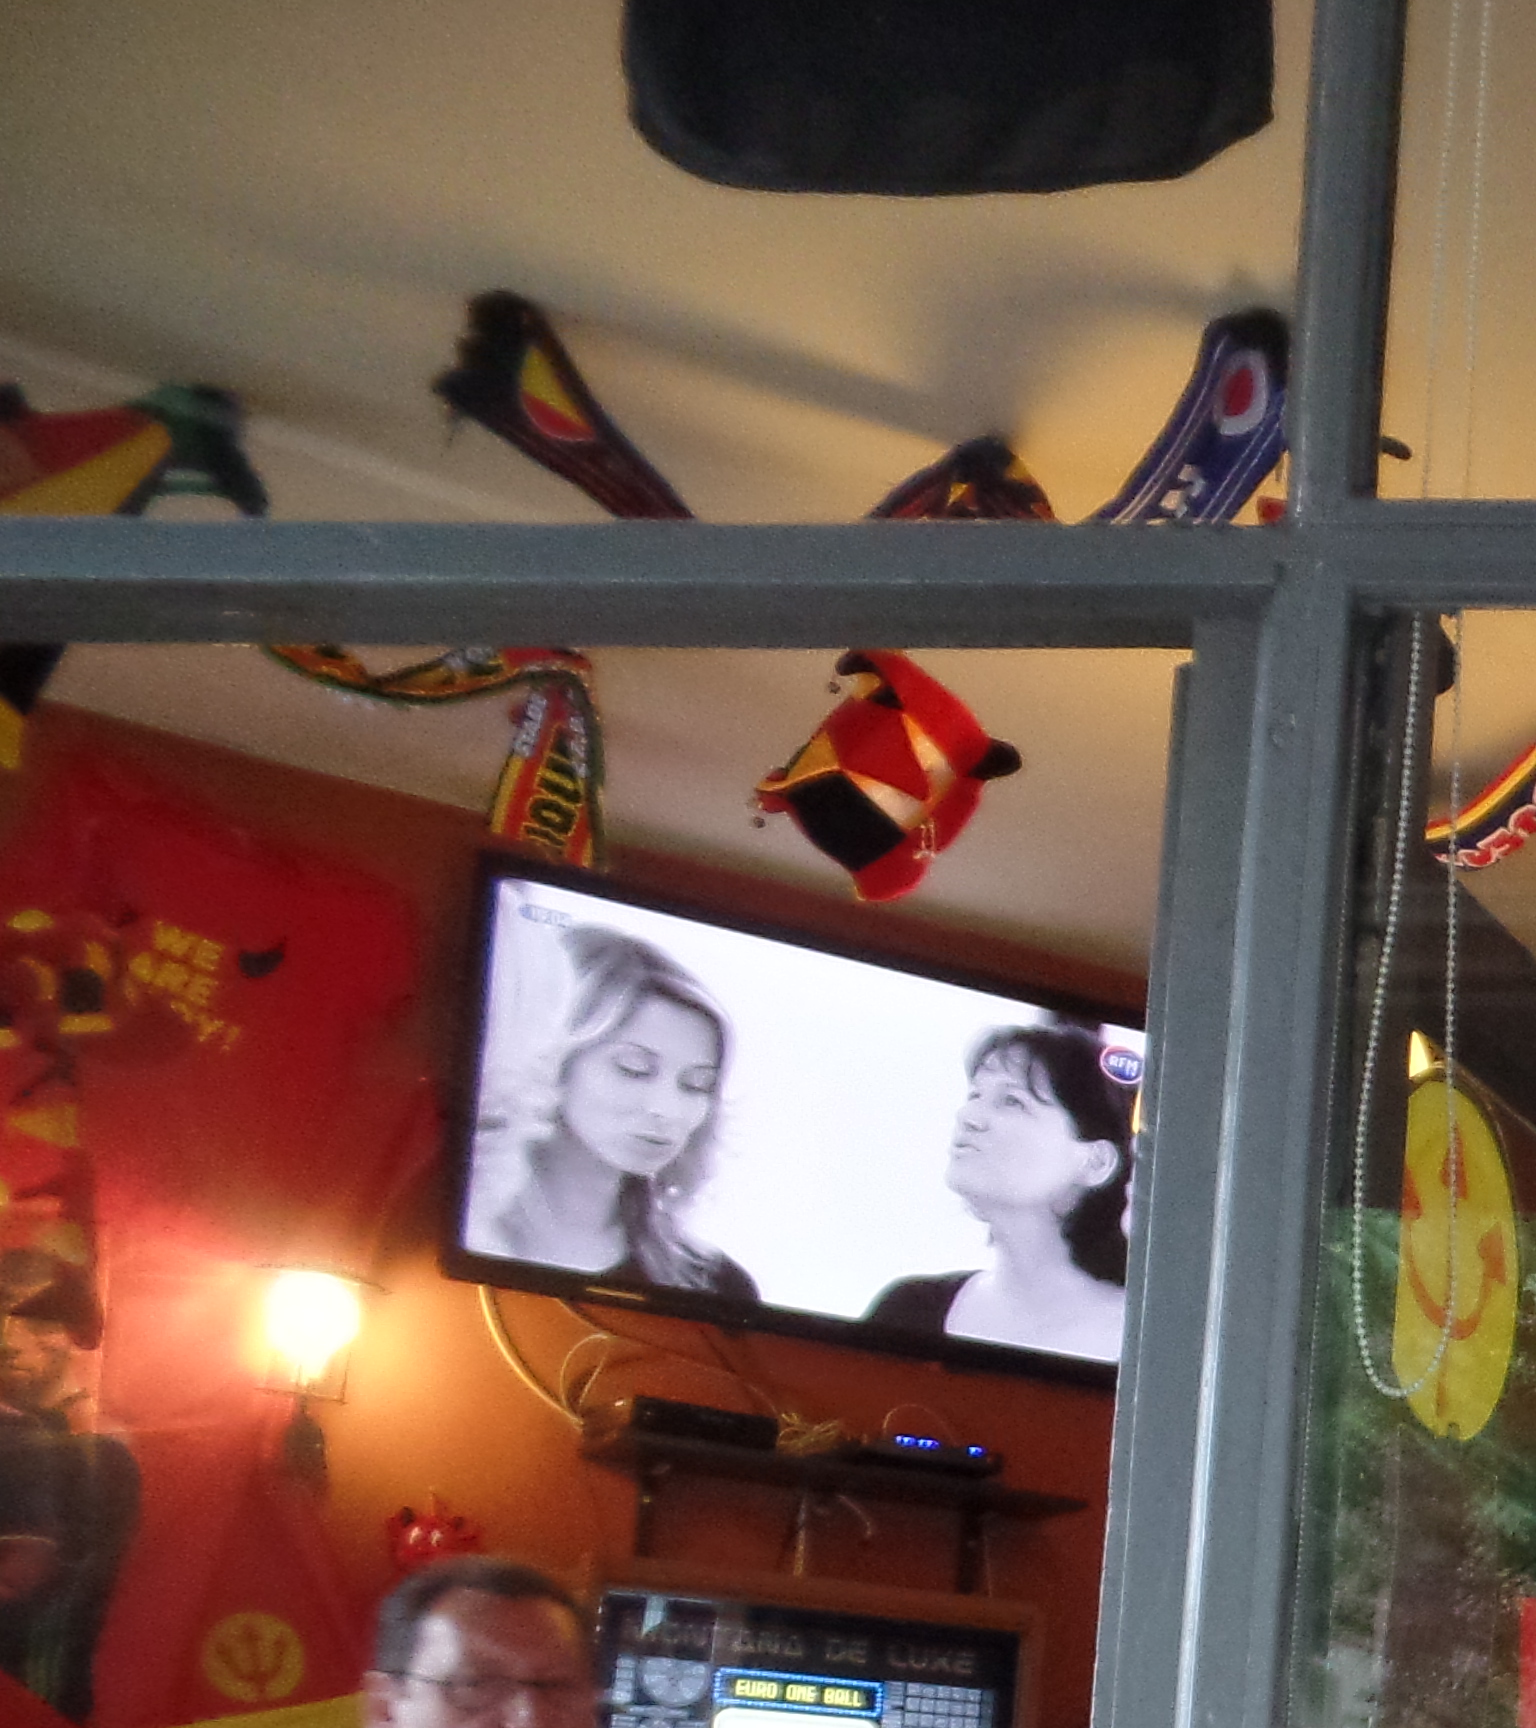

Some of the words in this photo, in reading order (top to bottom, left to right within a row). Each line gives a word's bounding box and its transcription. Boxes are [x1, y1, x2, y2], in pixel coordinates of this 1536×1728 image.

[735, 1679, 778, 1699] EURO
[786, 1684, 817, 1703] ONE
[823, 1687, 862, 1708] BALL
